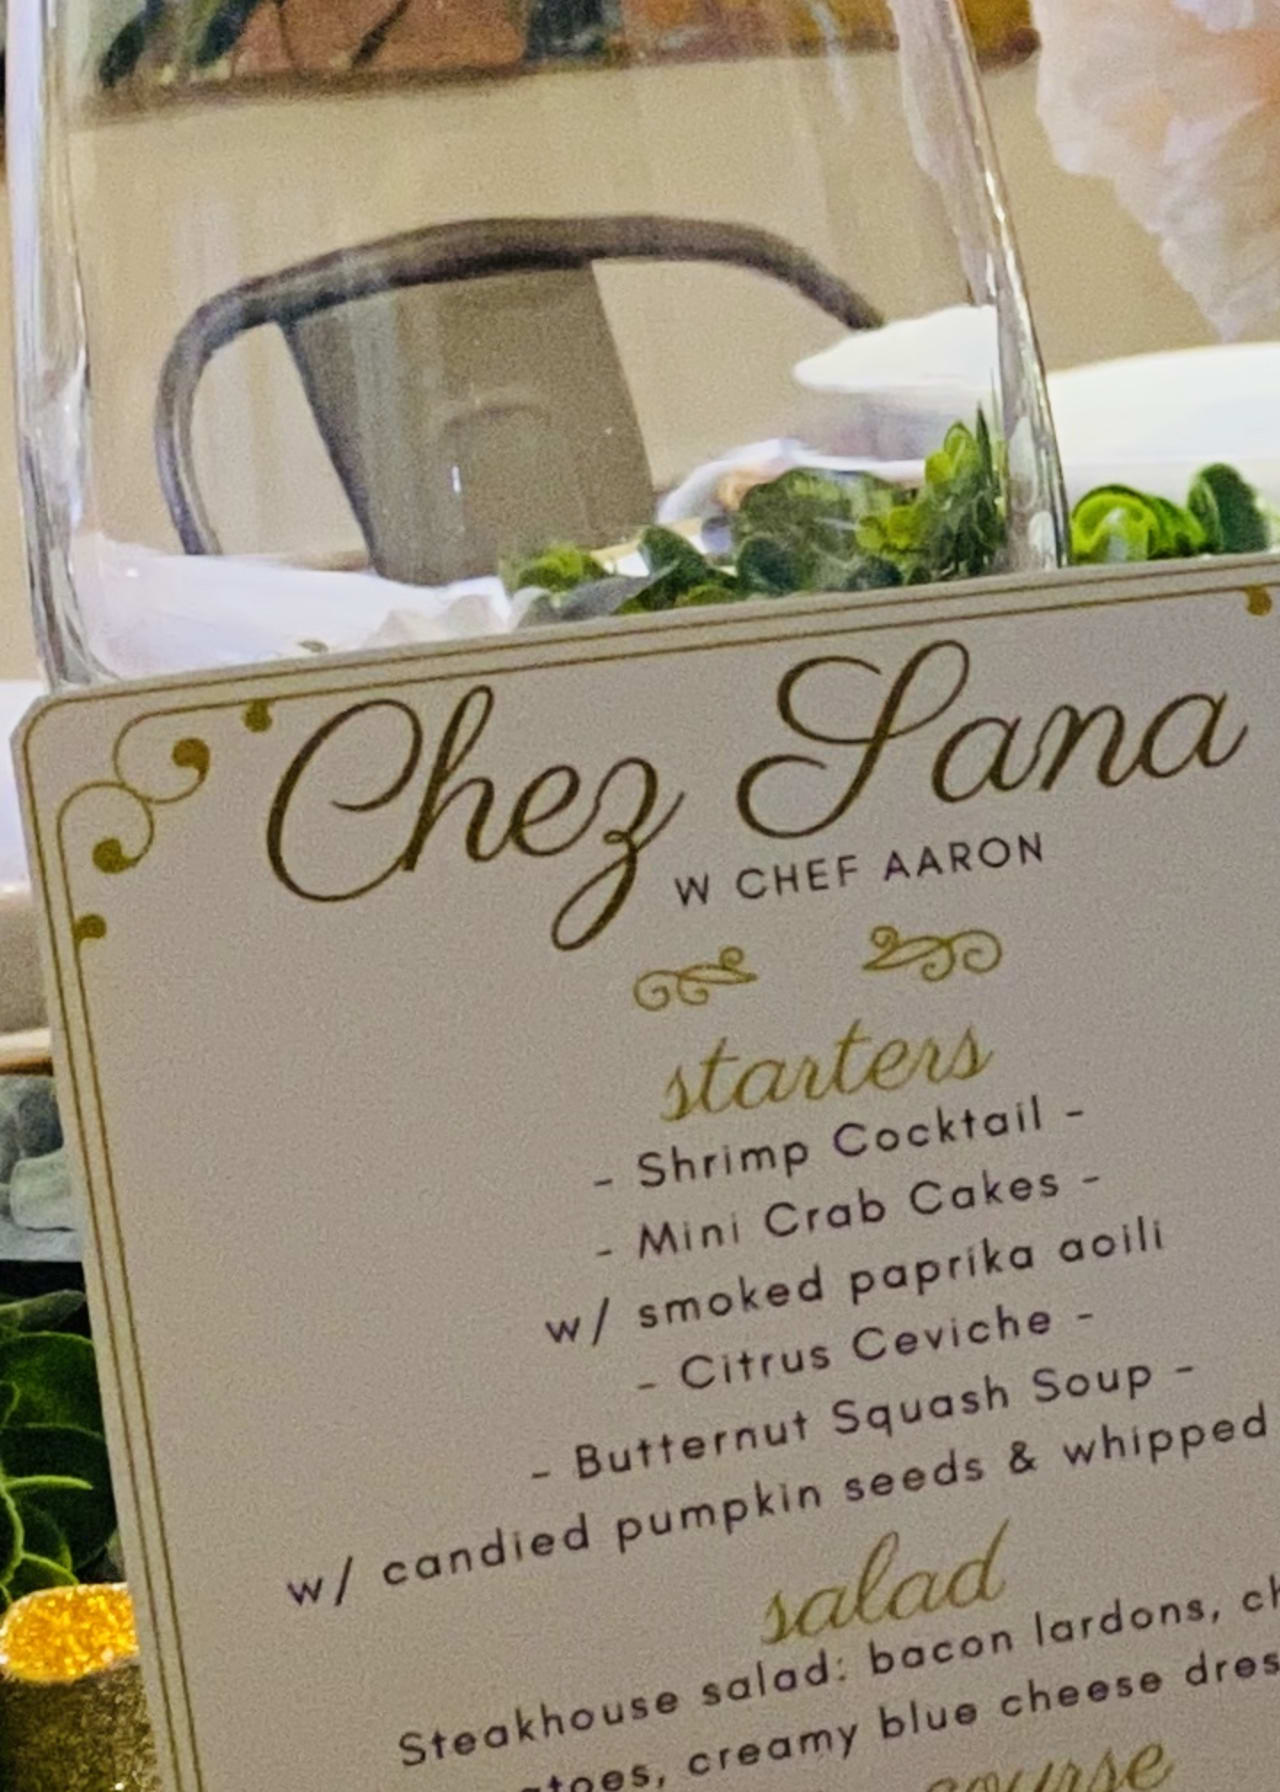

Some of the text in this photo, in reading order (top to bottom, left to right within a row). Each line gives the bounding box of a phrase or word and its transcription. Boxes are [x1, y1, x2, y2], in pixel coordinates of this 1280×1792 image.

[267, 640, 1248, 950] Chez Sana
[675, 832, 1044, 907] W CHEF AARON
[659, 1019, 995, 1122] starters
[638, 1141, 810, 1188] Shrimp
[832, 1095, 1042, 1157] Cocktail
[639, 1213, 740, 1259] Mini
[765, 1188, 886, 1238] Crab
[910, 1170, 1059, 1215] Cakes
[545, 1215, 1163, 1346] w/ smoked paprika aoili
[681, 1344, 831, 1390] Citrus
[852, 1305, 1051, 1362] Ceviche
[575, 1410, 808, 1480] Butternut
[832, 1375, 1010, 1437] Squash
[1032, 1365, 1152, 1403] Soup
[287, 1556, 353, 1607] w/
[382, 1512, 590, 1585] candied
[616, 1480, 821, 1553] pumpkin
[845, 1449, 985, 1502] seeds
[1008, 1440, 1038, 1474] &
[1063, 1401, 1267, 1465] whipped
[760, 1517, 1011, 1645] salad
[399, 1690, 679, 1767] Steakhouse
[701, 1648, 848, 1707] salad:
[868, 1639, 1013, 1676] bacon
[1035, 1598, 1220, 1647] lardons,
[688, 1722, 859, 1777] creamy
[880, 1701, 978, 1740] blue
[1001, 1670, 1163, 1718] cheese
